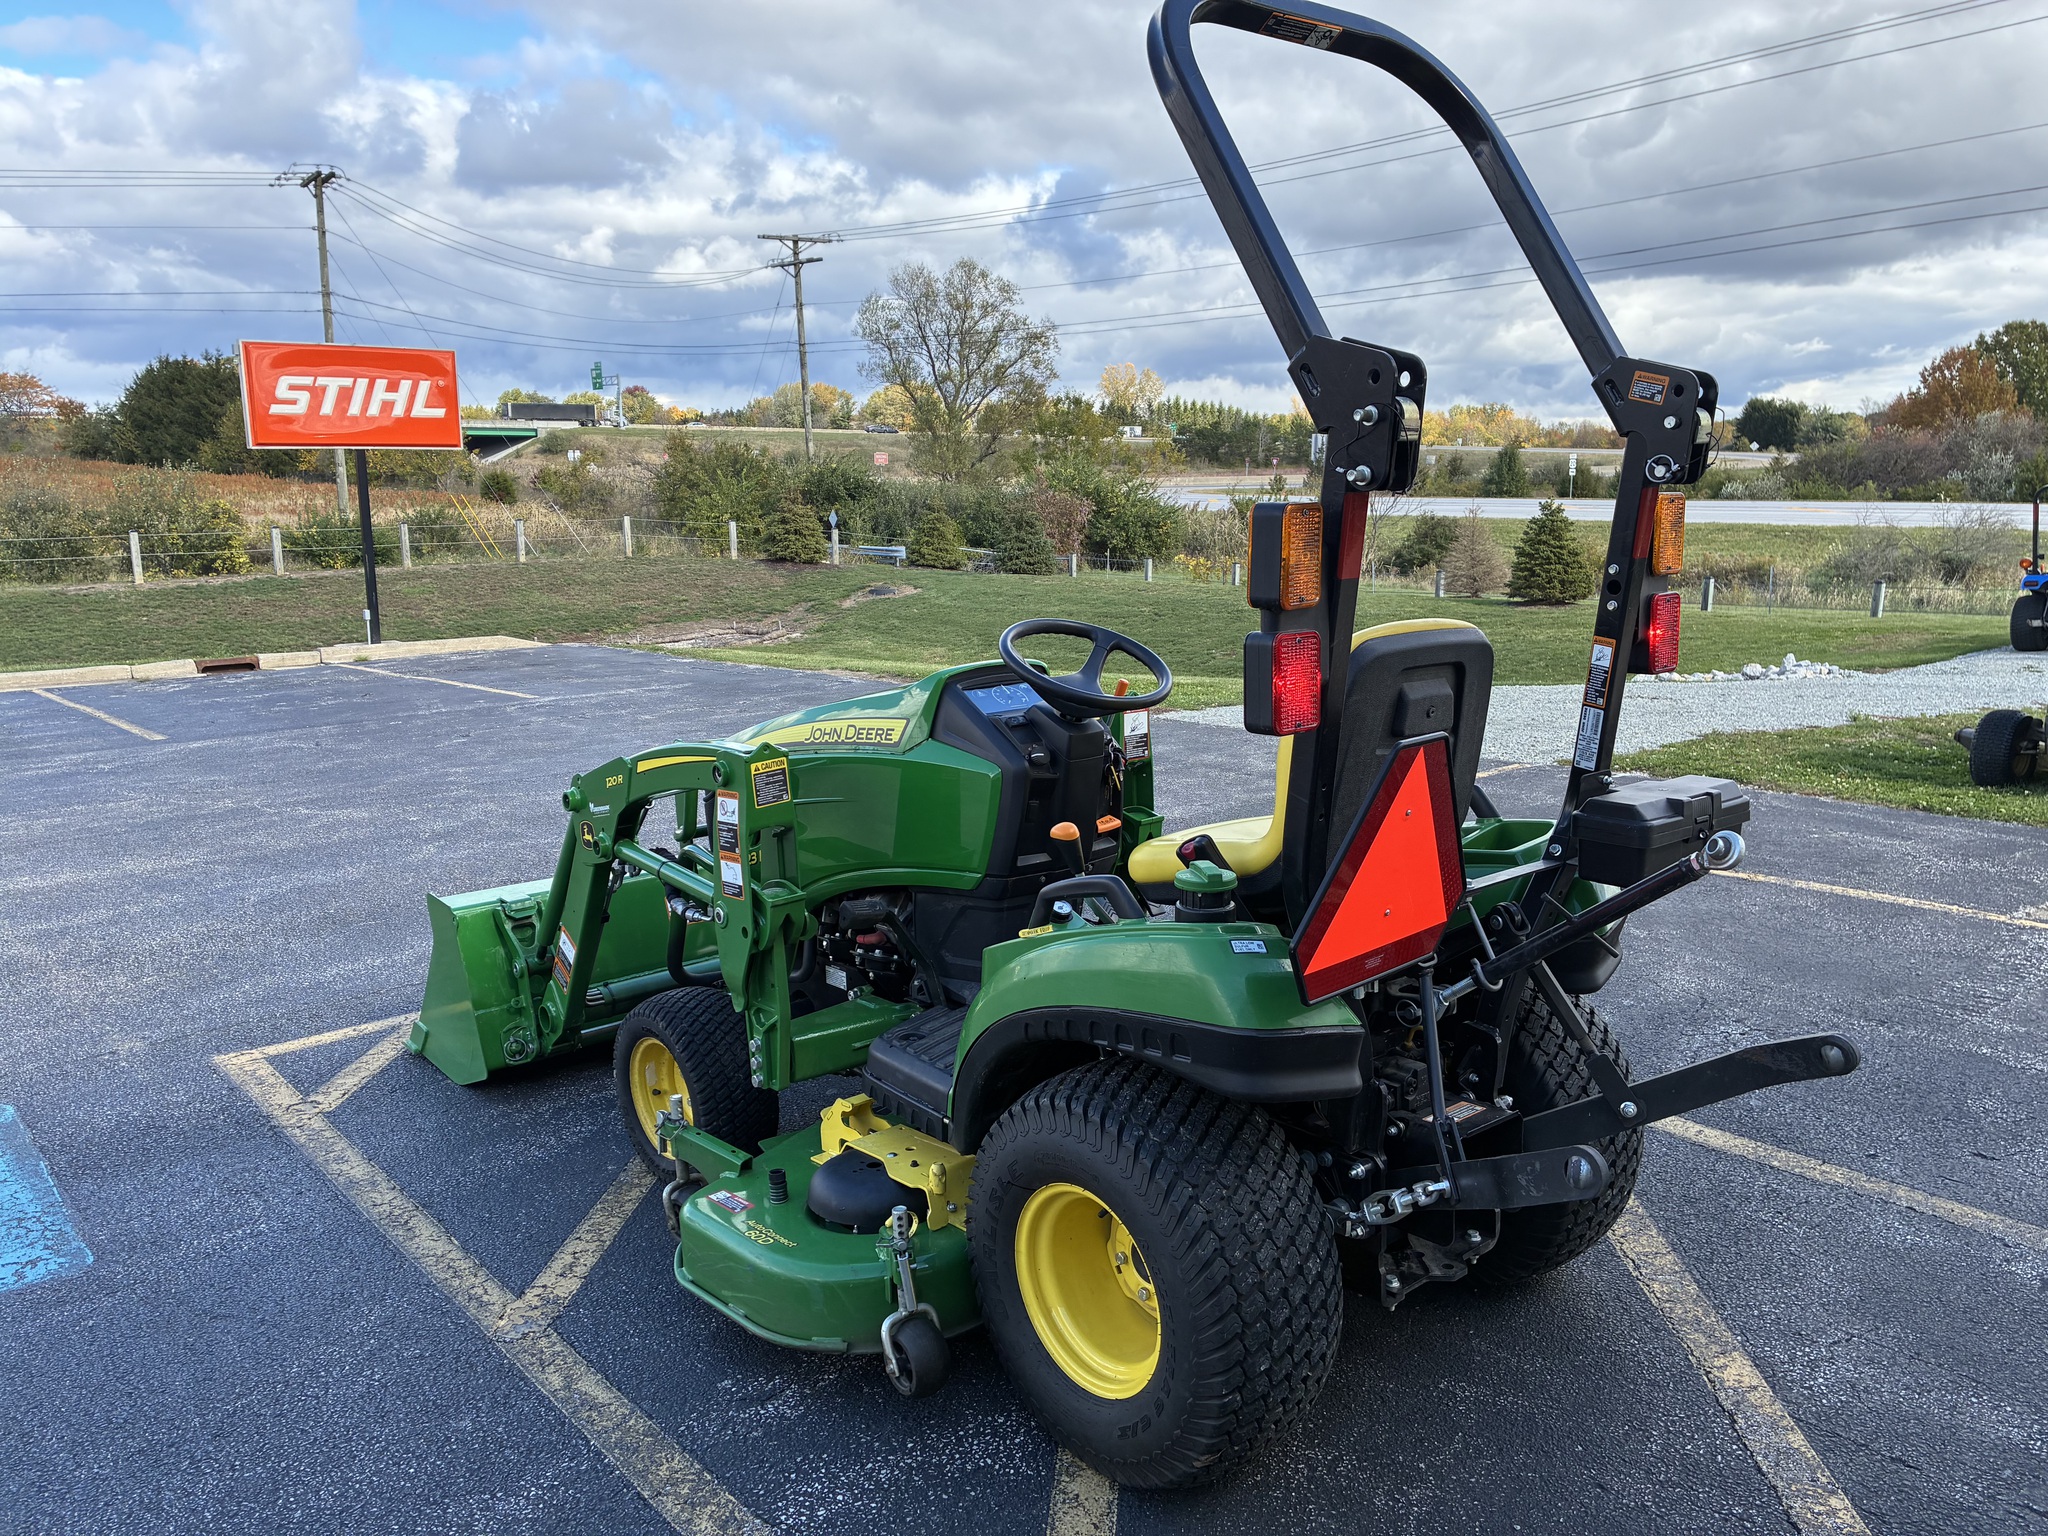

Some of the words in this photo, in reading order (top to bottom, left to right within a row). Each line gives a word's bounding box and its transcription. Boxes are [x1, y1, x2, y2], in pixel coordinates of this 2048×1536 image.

[268, 375, 447, 418] STIHL
[804, 725, 843, 742] JOHN
[844, 724, 896, 742] DEERE
[760, 758, 786, 771] CAUTION
[744, 1230, 774, 1245] 60D
[983, 1159, 1024, 1320] CARLISLE
